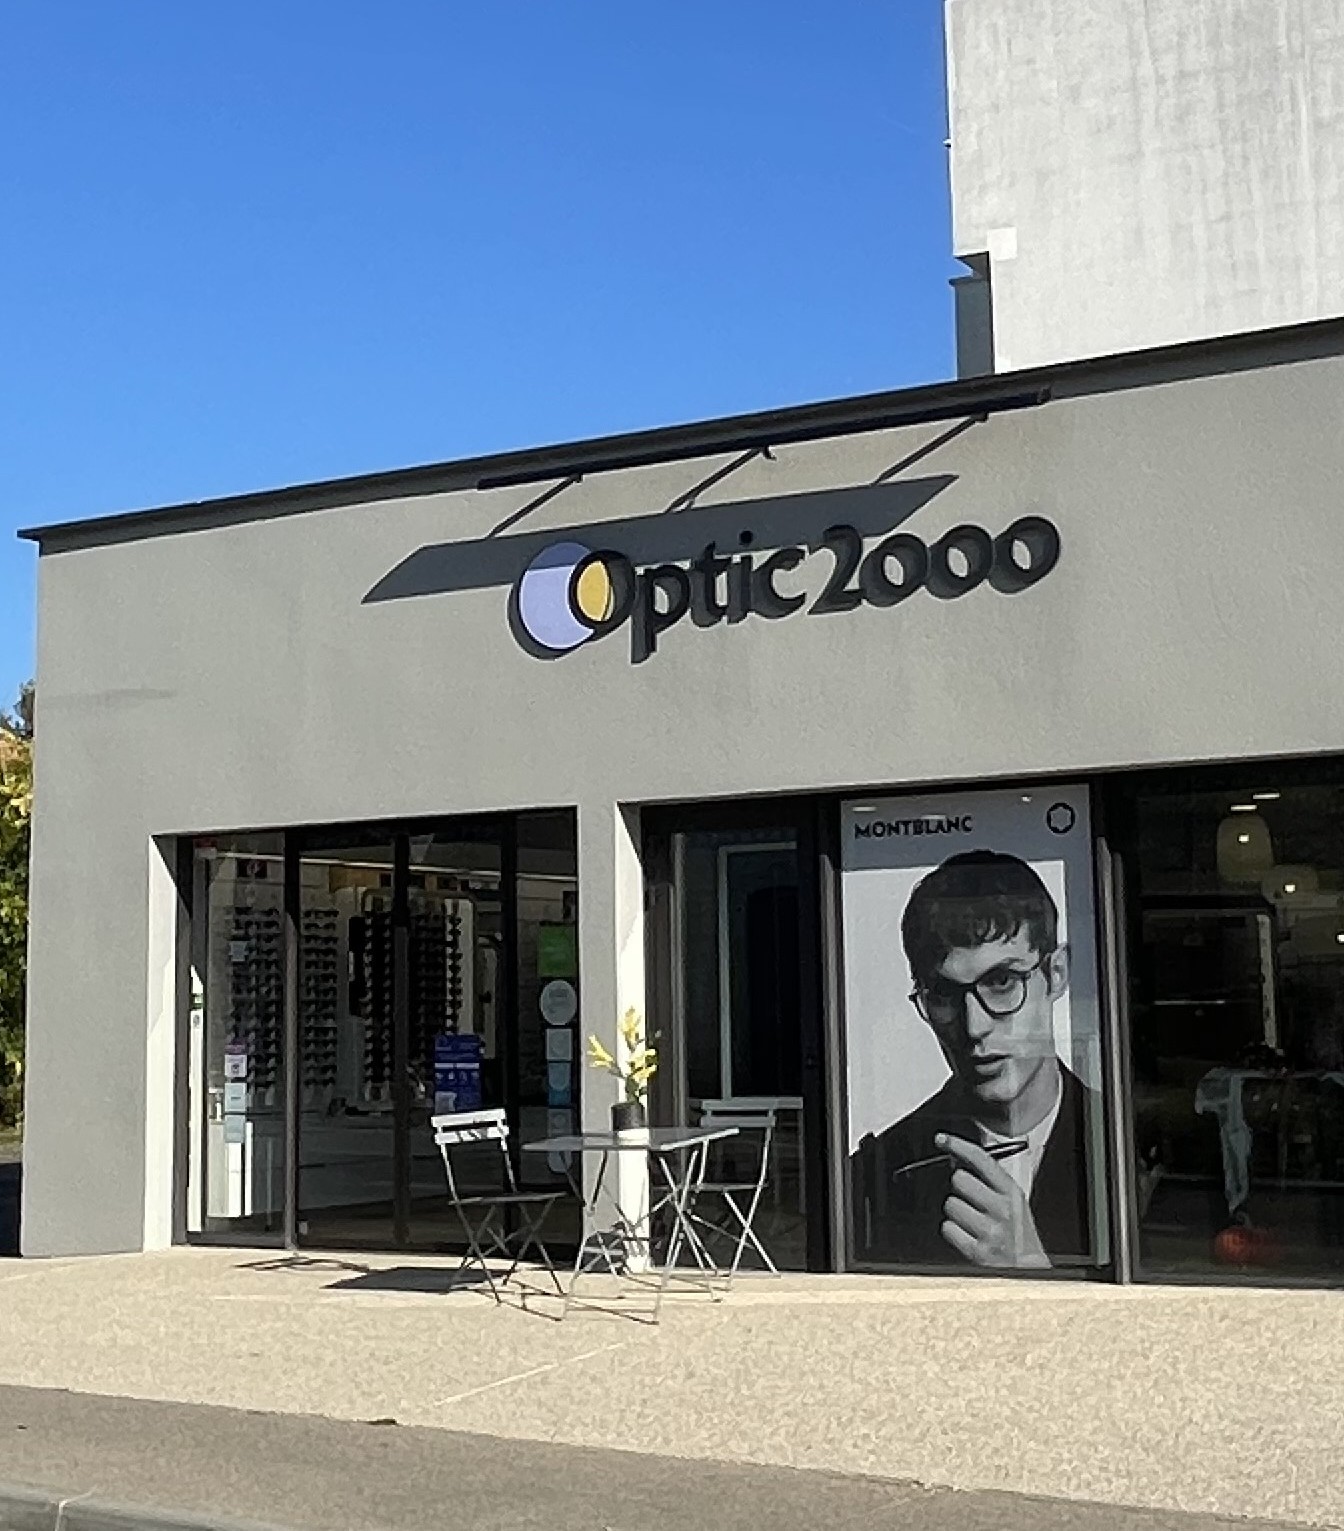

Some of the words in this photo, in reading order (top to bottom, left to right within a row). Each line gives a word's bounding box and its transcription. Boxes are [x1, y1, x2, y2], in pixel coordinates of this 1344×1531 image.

[566, 530, 806, 664] Optic
[808, 515, 1060, 616] 2000
[855, 815, 975, 839] MONTBLANC
